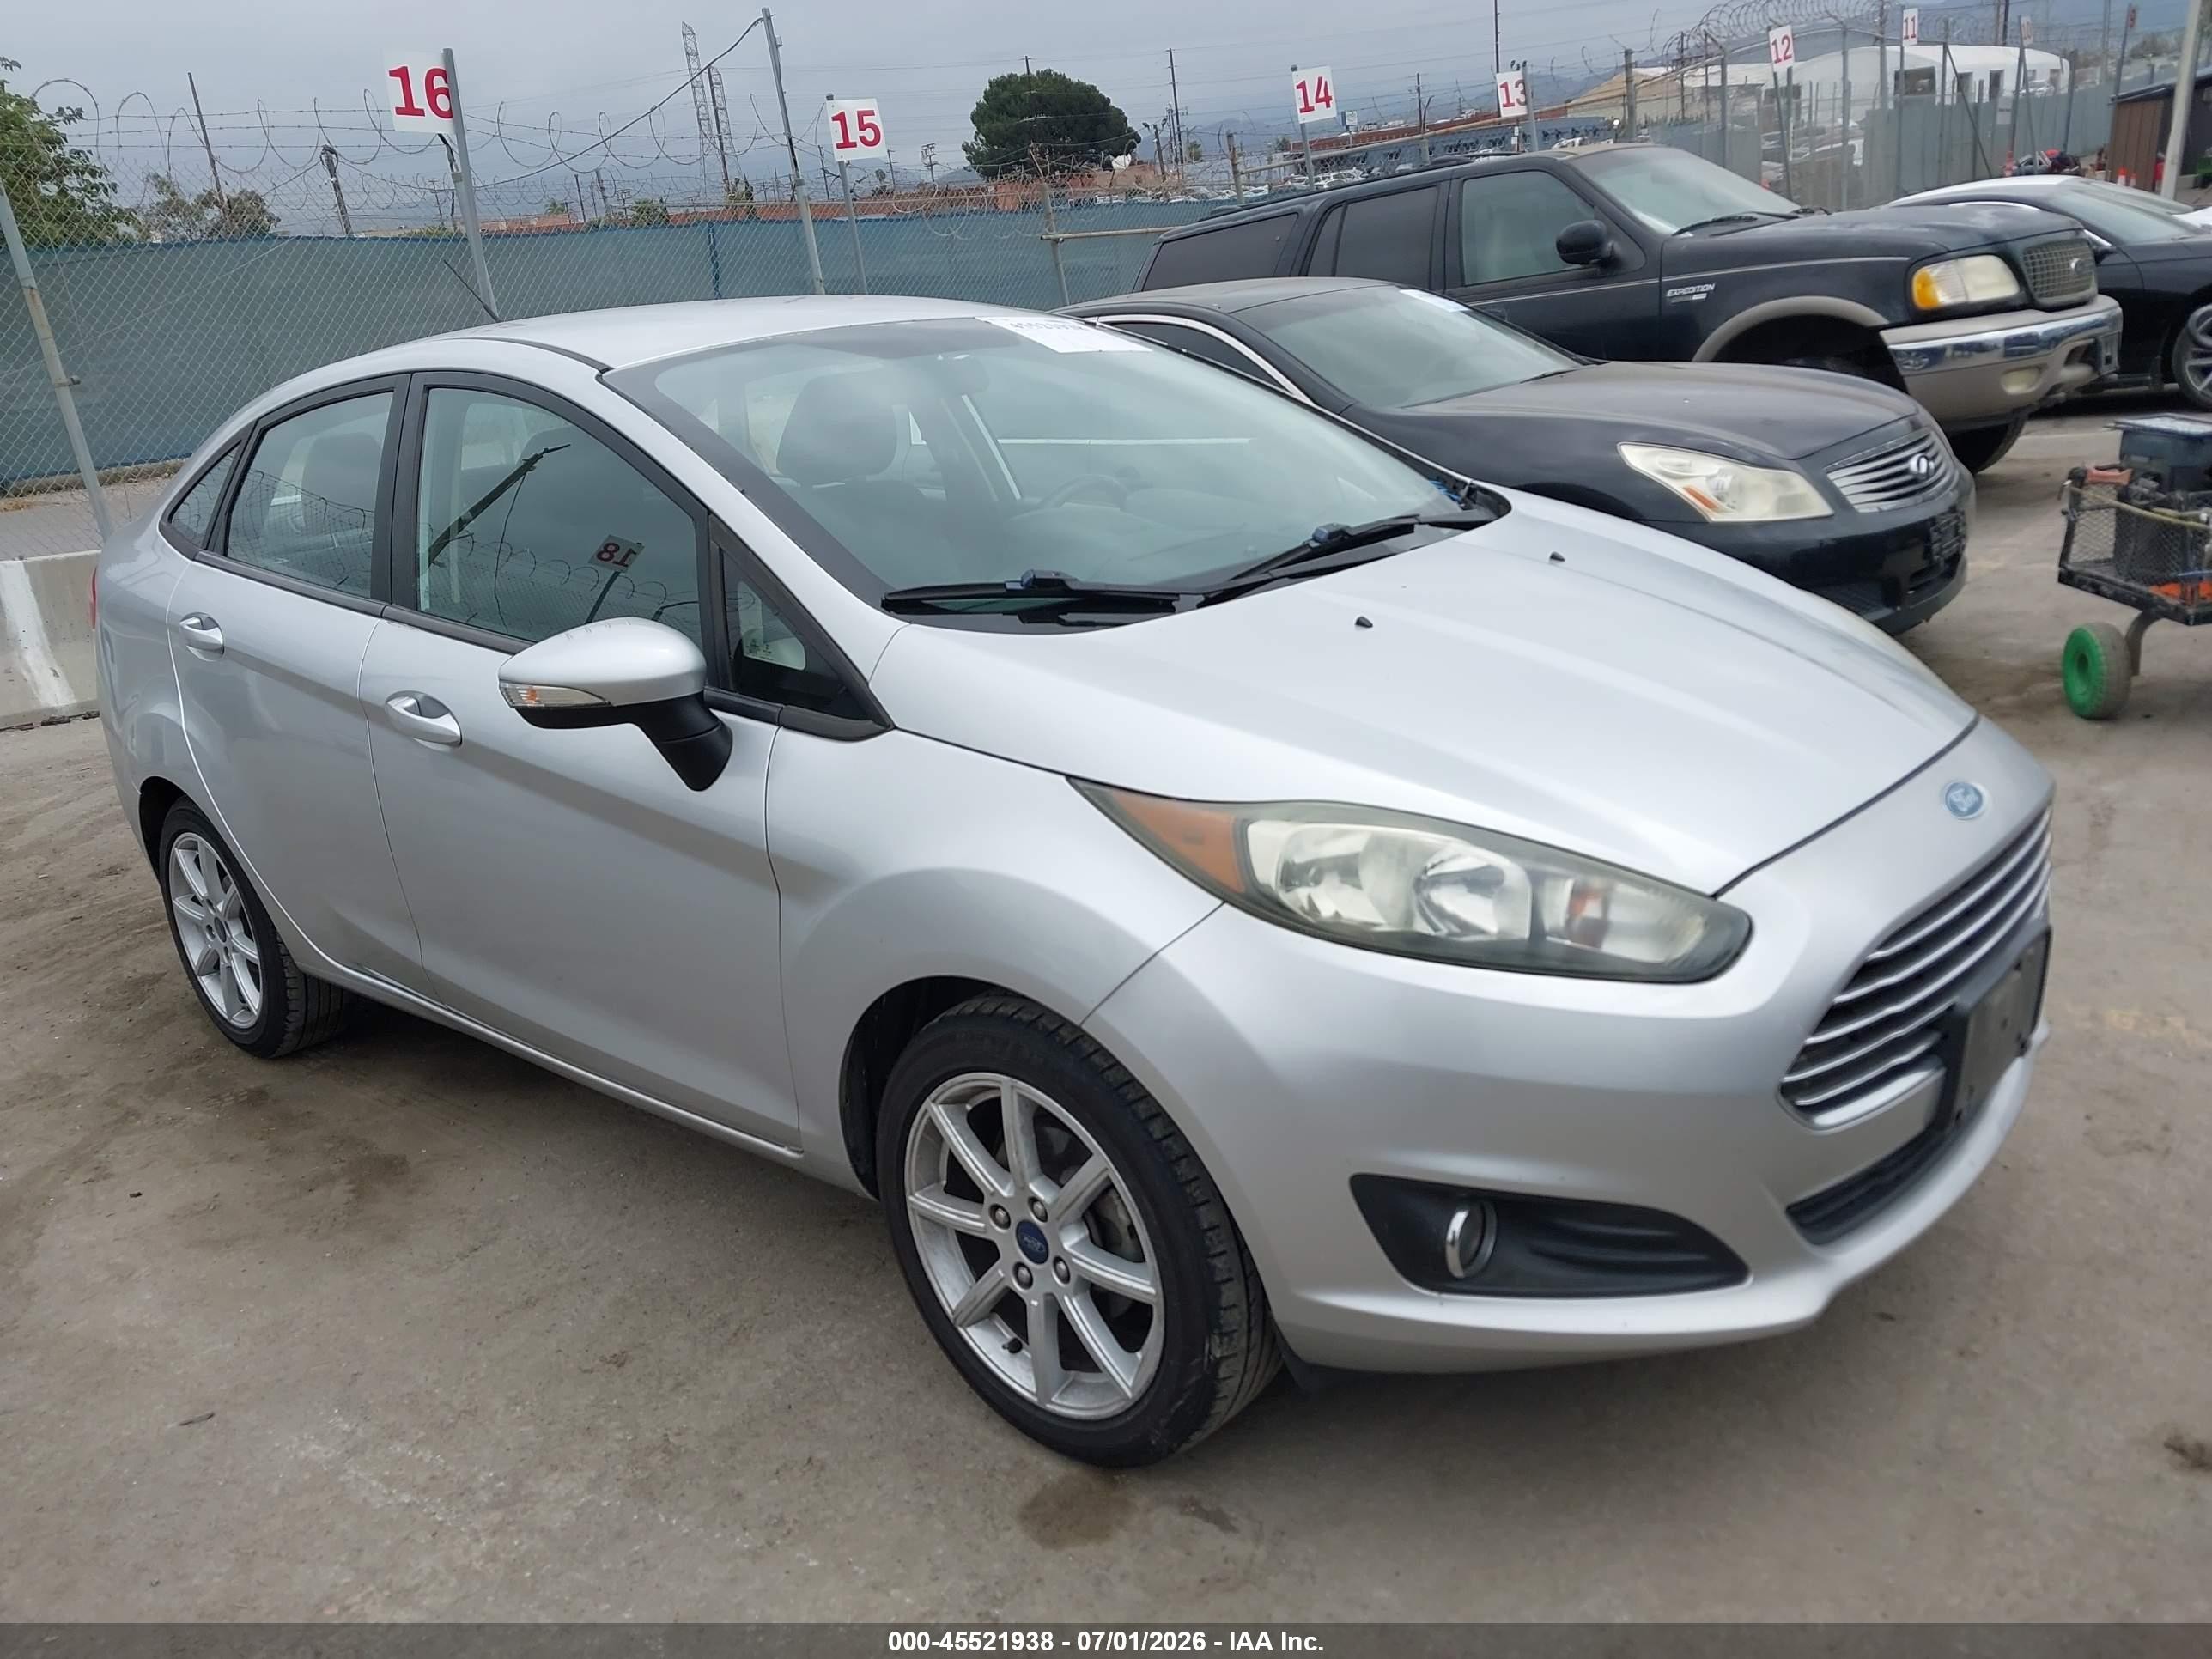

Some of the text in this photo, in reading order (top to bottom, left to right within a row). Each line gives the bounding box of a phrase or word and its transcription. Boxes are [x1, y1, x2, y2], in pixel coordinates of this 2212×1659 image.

[1904, 15, 1917, 40] 11
[1771, 34, 1793, 64] 12
[388, 65, 454, 119] 16
[1296, 76, 1333, 113] 14
[1499, 78, 1527, 108] 13
[831, 109, 881, 149] 15
